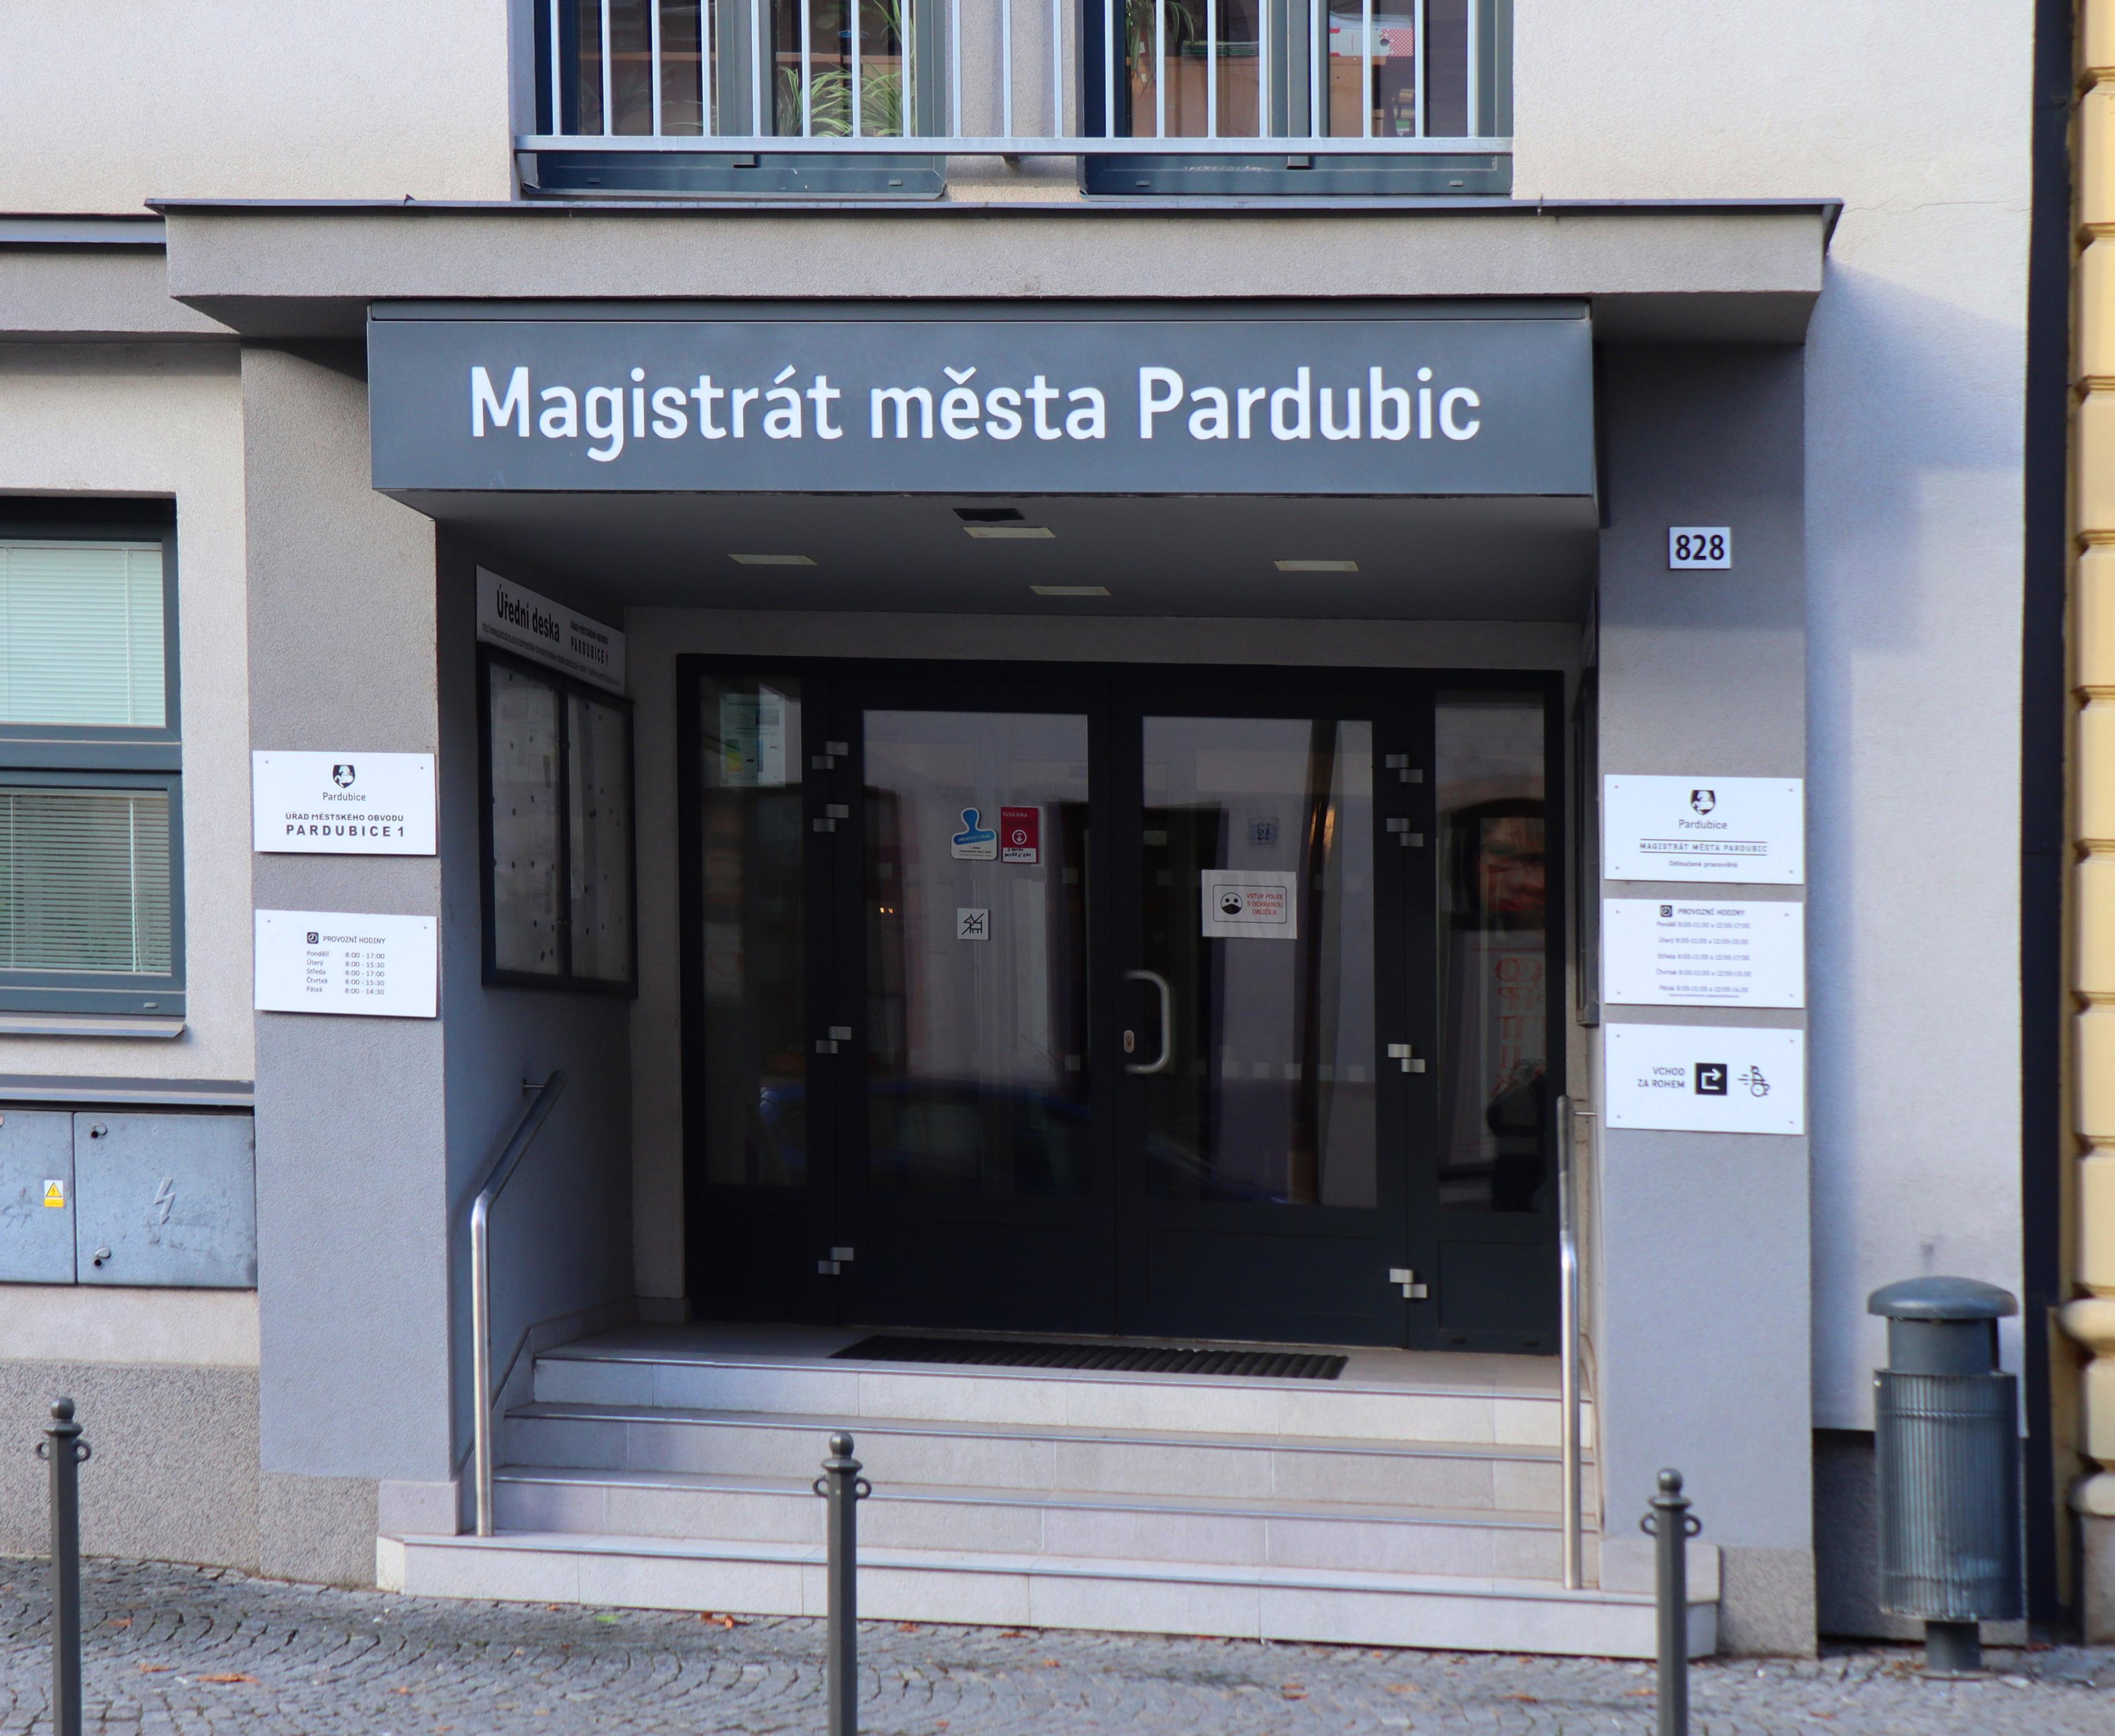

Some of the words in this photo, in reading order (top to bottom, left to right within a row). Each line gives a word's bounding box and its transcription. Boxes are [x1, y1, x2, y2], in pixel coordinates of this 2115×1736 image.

[472, 364, 843, 462] Magistrát
[871, 366, 1105, 440] města
[1140, 366, 1480, 440] Pardubic
[1676, 535, 1724, 560] 828
[496, 584, 529, 630] Úřední
[532, 608, 560, 643] deska
[571, 636, 604, 664] PARDUBICE
[323, 792, 366, 801] Pardubice
[312, 812, 365, 821] MĚSTSKÉHO
[1679, 819, 1727, 829] Pardubice
[286, 825, 391, 837] PARDUBICE
[398, 826, 403, 837] 1
[1639, 842, 1690, 851] MAGISTRÁT
[1693, 843, 1721, 851] MĚSTA
[307, 958, 323, 966] Úterý
[1653, 1067, 1685, 1076] VCHOD
[1652, 1080, 1684, 1088] ROHEM
